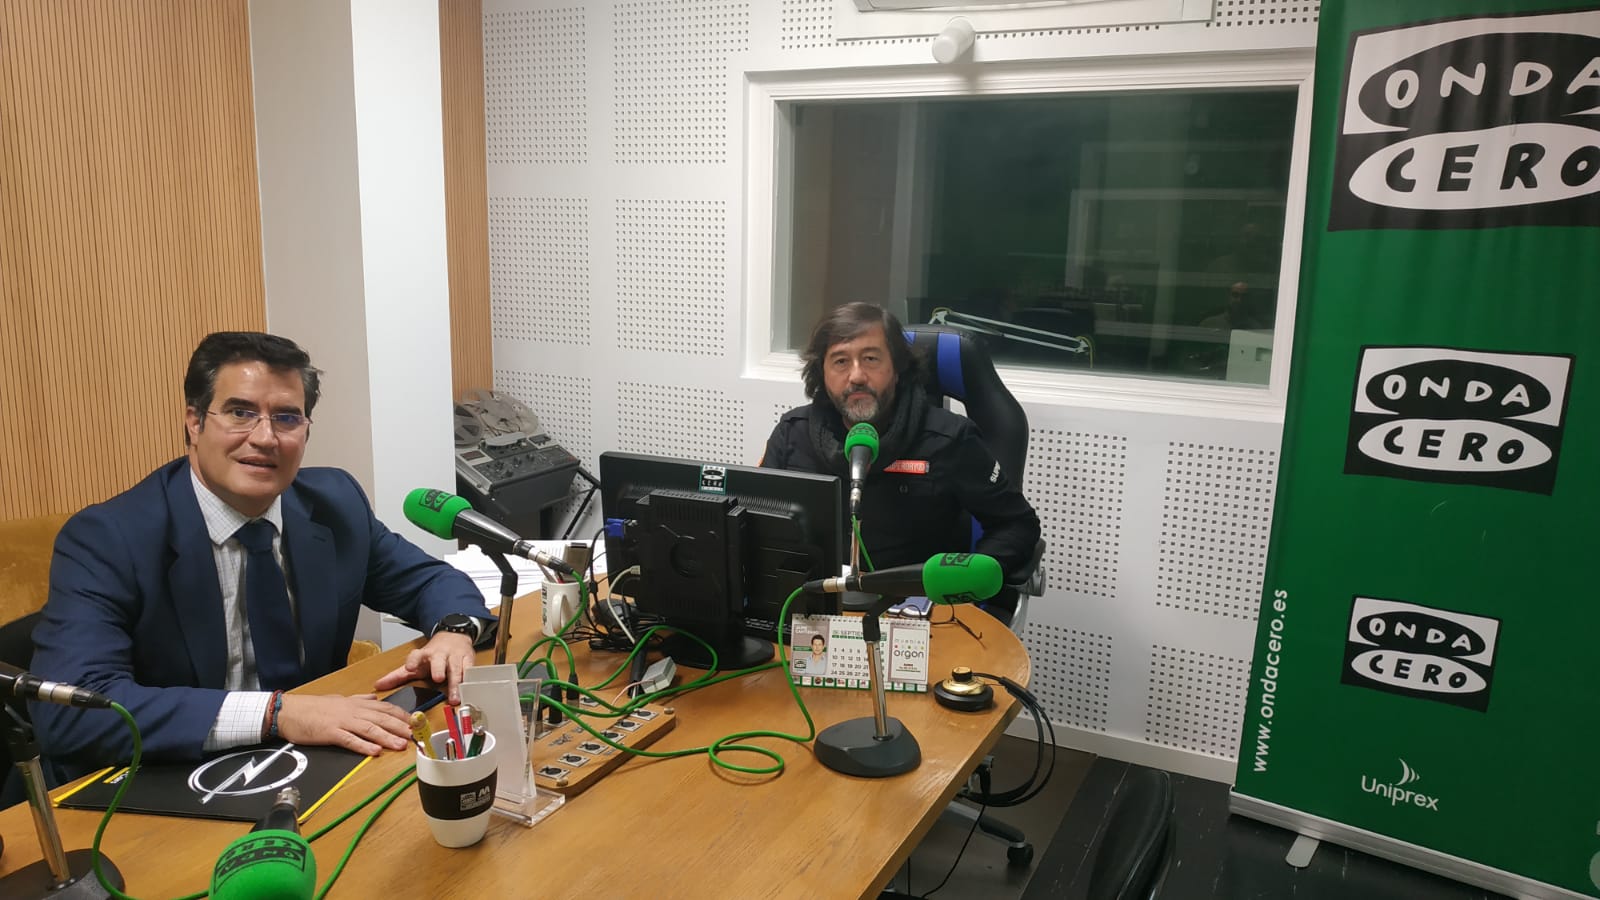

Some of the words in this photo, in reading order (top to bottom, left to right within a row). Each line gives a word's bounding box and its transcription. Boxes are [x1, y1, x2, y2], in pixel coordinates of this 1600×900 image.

[1385, 57, 1600, 109] ONDA
[1385, 142, 1600, 193] CERO
[1383, 374, 1530, 408] ONDA
[1383, 426, 1525, 464] CERO
[1368, 617, 1472, 652] ONDA
[1253, 589, 1288, 773] www.ondacero.es
[1368, 654, 1468, 689] CERO
[1361, 775, 1439, 811] Uniprex
